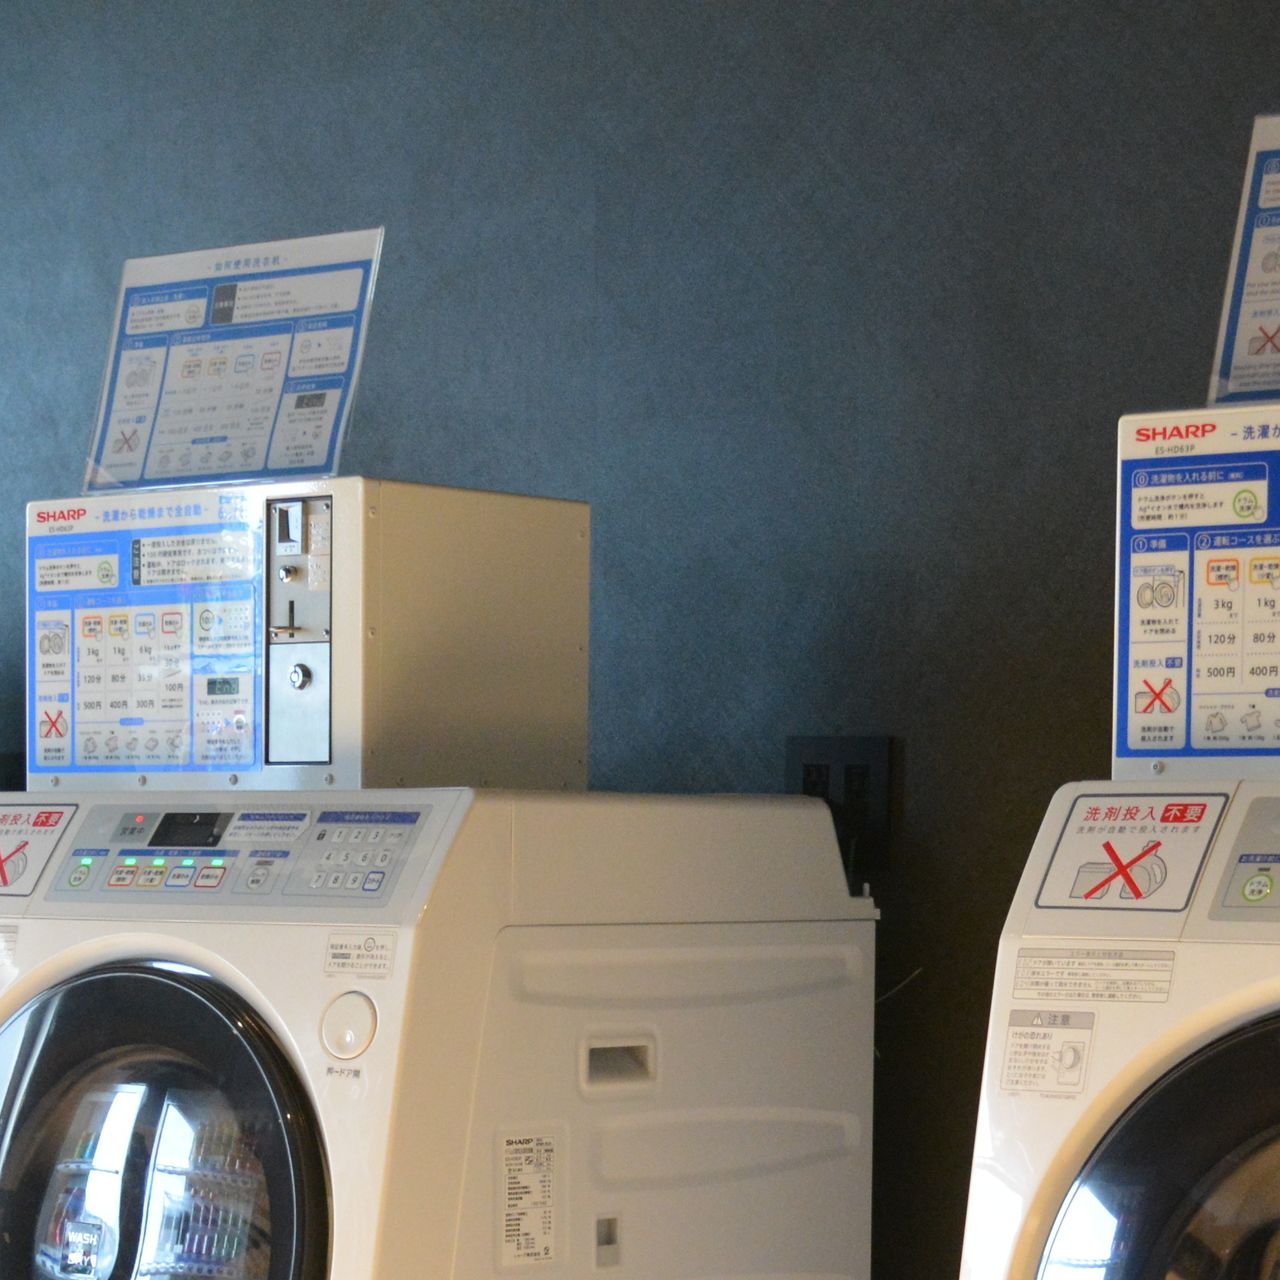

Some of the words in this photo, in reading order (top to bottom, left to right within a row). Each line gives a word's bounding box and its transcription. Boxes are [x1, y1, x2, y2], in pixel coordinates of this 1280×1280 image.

[1134, 423, 1217, 442] SHARP
[1154, 444, 1196, 456] ES-HD63P
[36, 508, 87, 524] SHARP
[1213, 533, 1280, 547] 運転コースを選ぶ
[33, 811, 62, 828] 不要
[1082, 805, 1157, 822] 洗剤投入
[1162, 803, 1207, 823] 不要
[1075, 824, 1202, 835] 洗剤が自動で投入されます
[1046, 1013, 1071, 1026] 注意
[505, 1138, 533, 1146] SHARP
[68, 1231, 97, 1246] WASH
